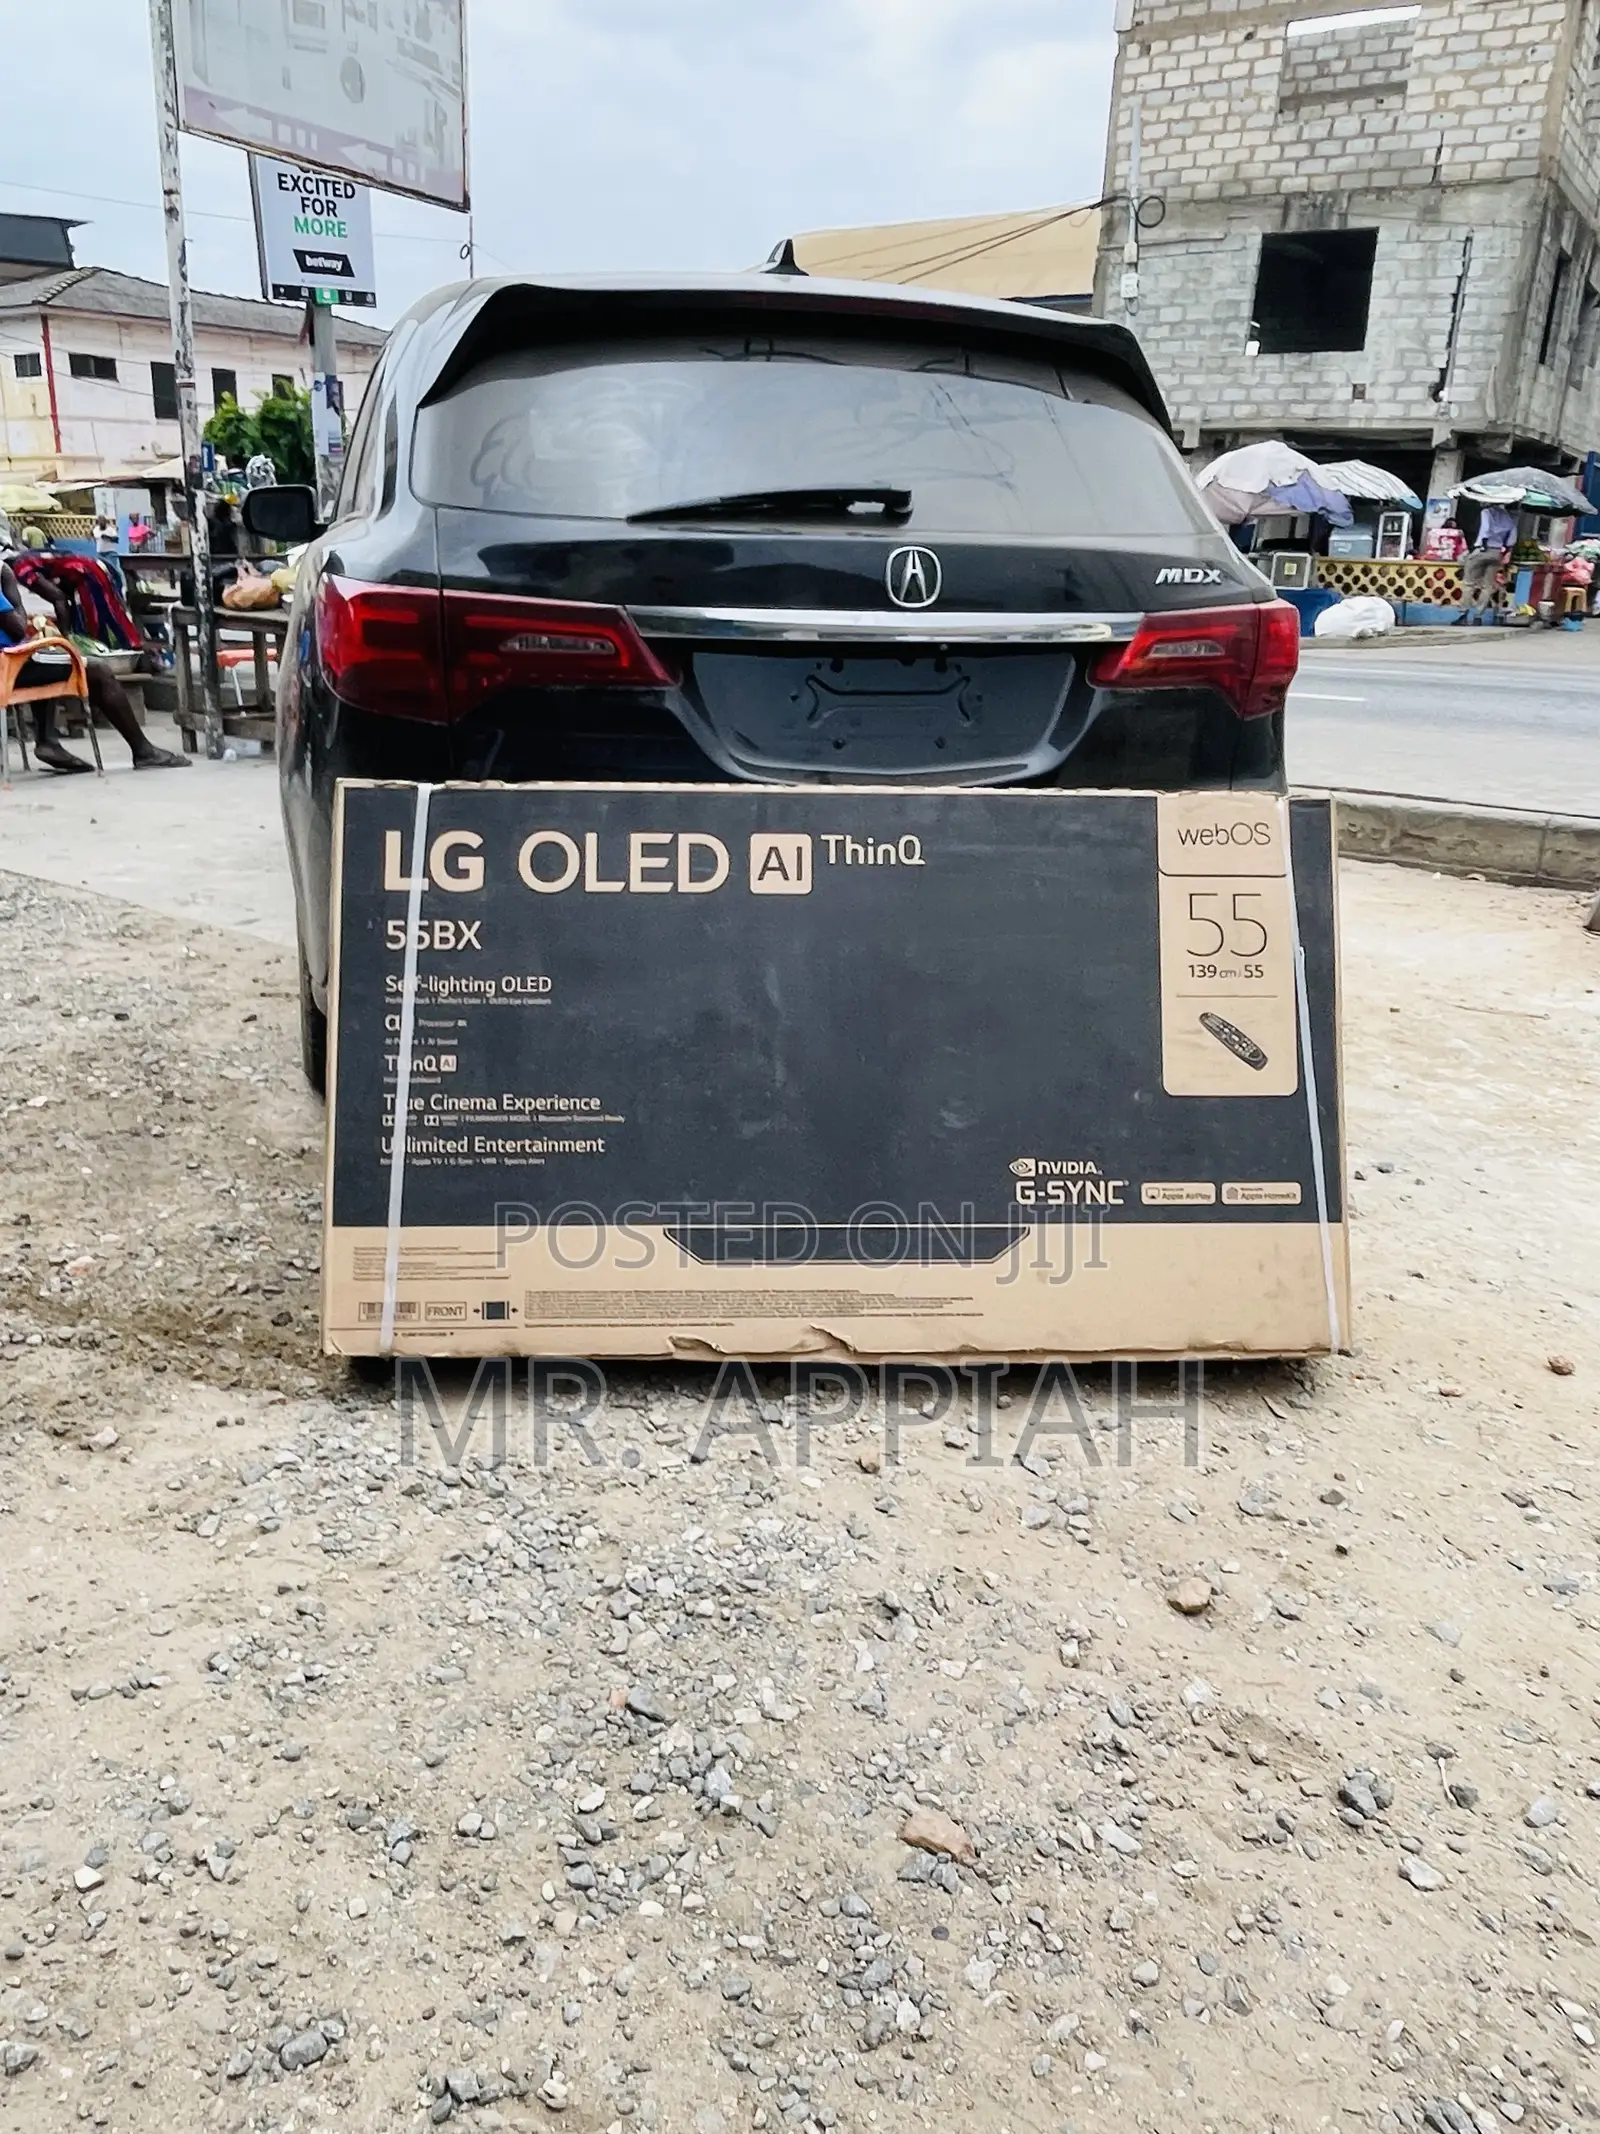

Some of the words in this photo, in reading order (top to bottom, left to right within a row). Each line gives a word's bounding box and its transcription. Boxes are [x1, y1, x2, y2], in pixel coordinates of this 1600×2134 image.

[277, 172, 356, 199] EXCITED
[300, 196, 338, 218] FOR
[293, 215, 348, 238] MORE
[305, 254, 343, 272] betway
[1155, 567, 1222, 585] MDX
[1177, 822, 1271, 846] webOS
[384, 829, 485, 893] LG
[518, 830, 730, 894] OLED
[756, 844, 808, 883] AI
[821, 834, 926, 866] ThinQ
[385, 920, 482, 951] 55BX
[1186, 893, 1267, 957] 55
[1189, 964, 1217, 979] 139
[1244, 964, 1264, 979] 55
[385, 975, 496, 997] Sef-lighting
[501, 975, 552, 993] OLED
[384, 1054, 438, 1072] TnQ
[383, 1094, 425, 1111] Tue
[430, 1094, 498, 1111] Cinema
[502, 1094, 601, 1113] Experience
[381, 1136, 468, 1154] Ulimited
[474, 1136, 606, 1154] Entertainment
[1015, 1179, 1125, 1205] G-SYNC
[427, 1306, 464, 1317] FRONT
